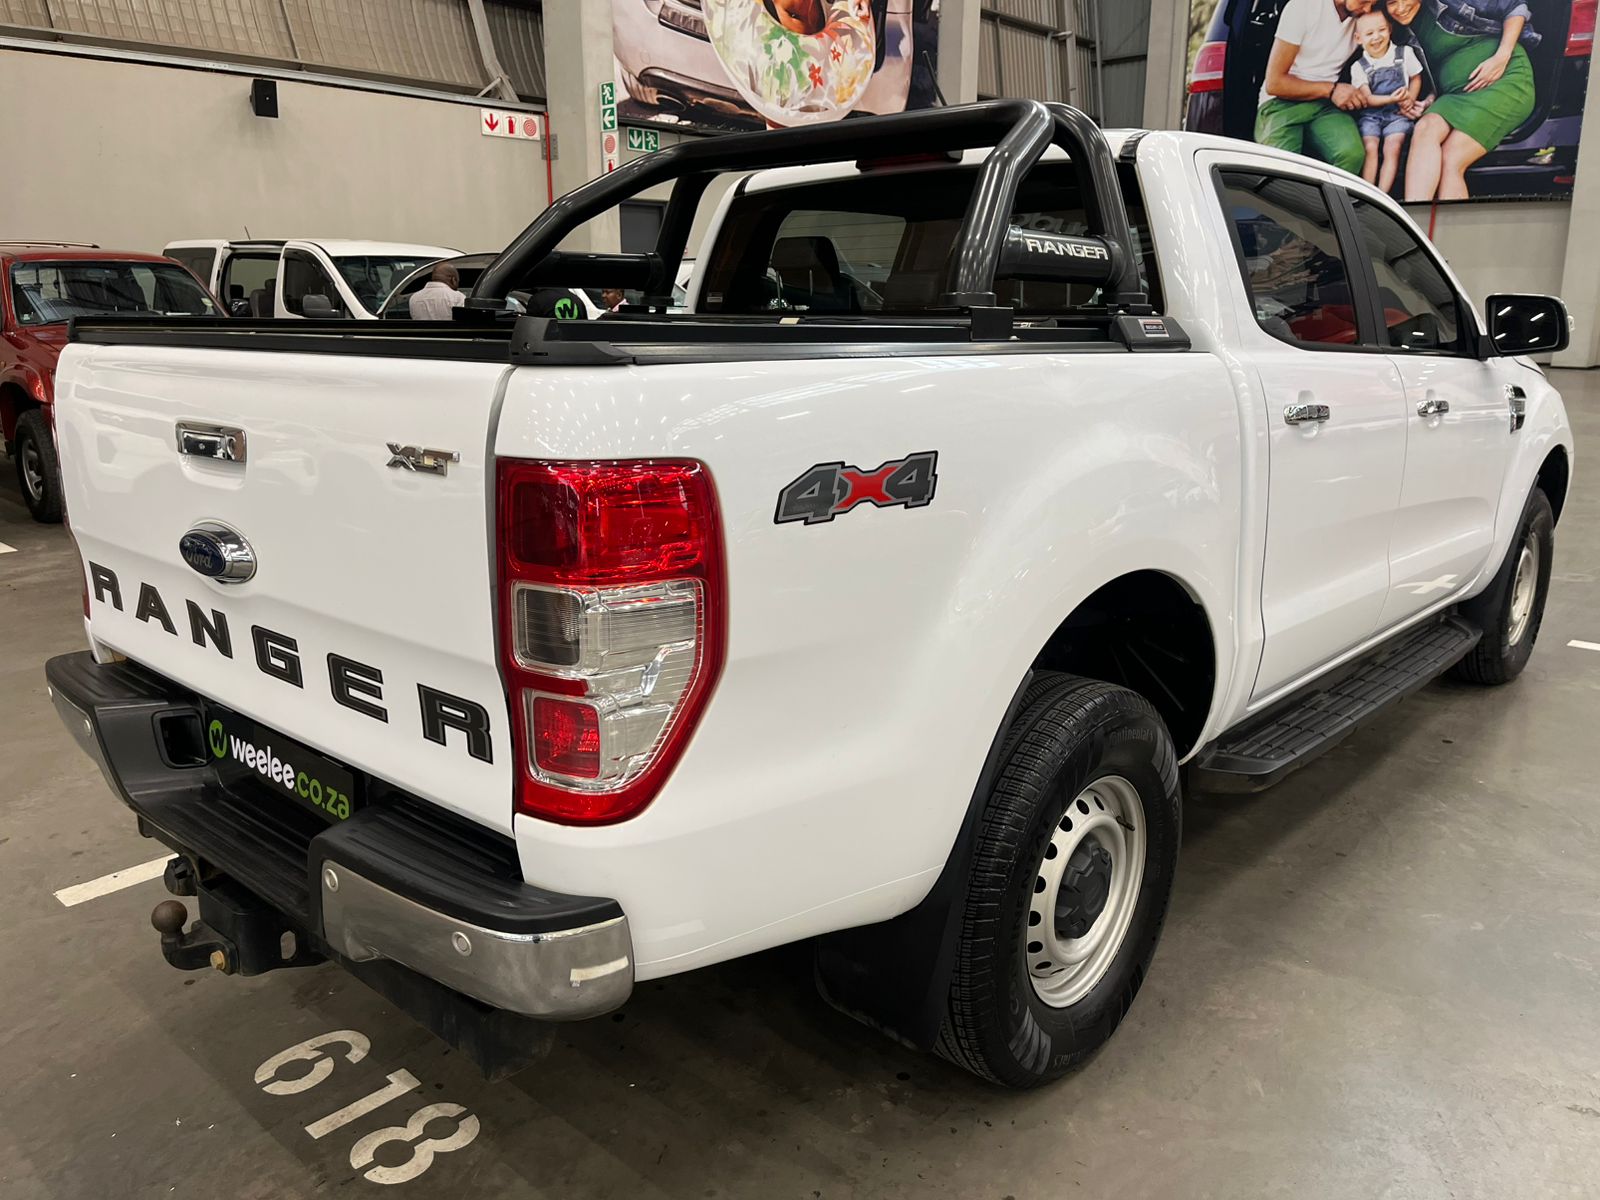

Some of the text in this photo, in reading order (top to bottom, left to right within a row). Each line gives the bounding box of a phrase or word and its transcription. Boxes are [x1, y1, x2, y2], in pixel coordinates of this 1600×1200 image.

[1025, 238, 1109, 260] RANGER
[386, 442, 460, 476] XLT
[90, 561, 493, 764] RANGER
[231, 736, 350, 820] weelee.co.za
[254, 1030, 480, 1185] 618
